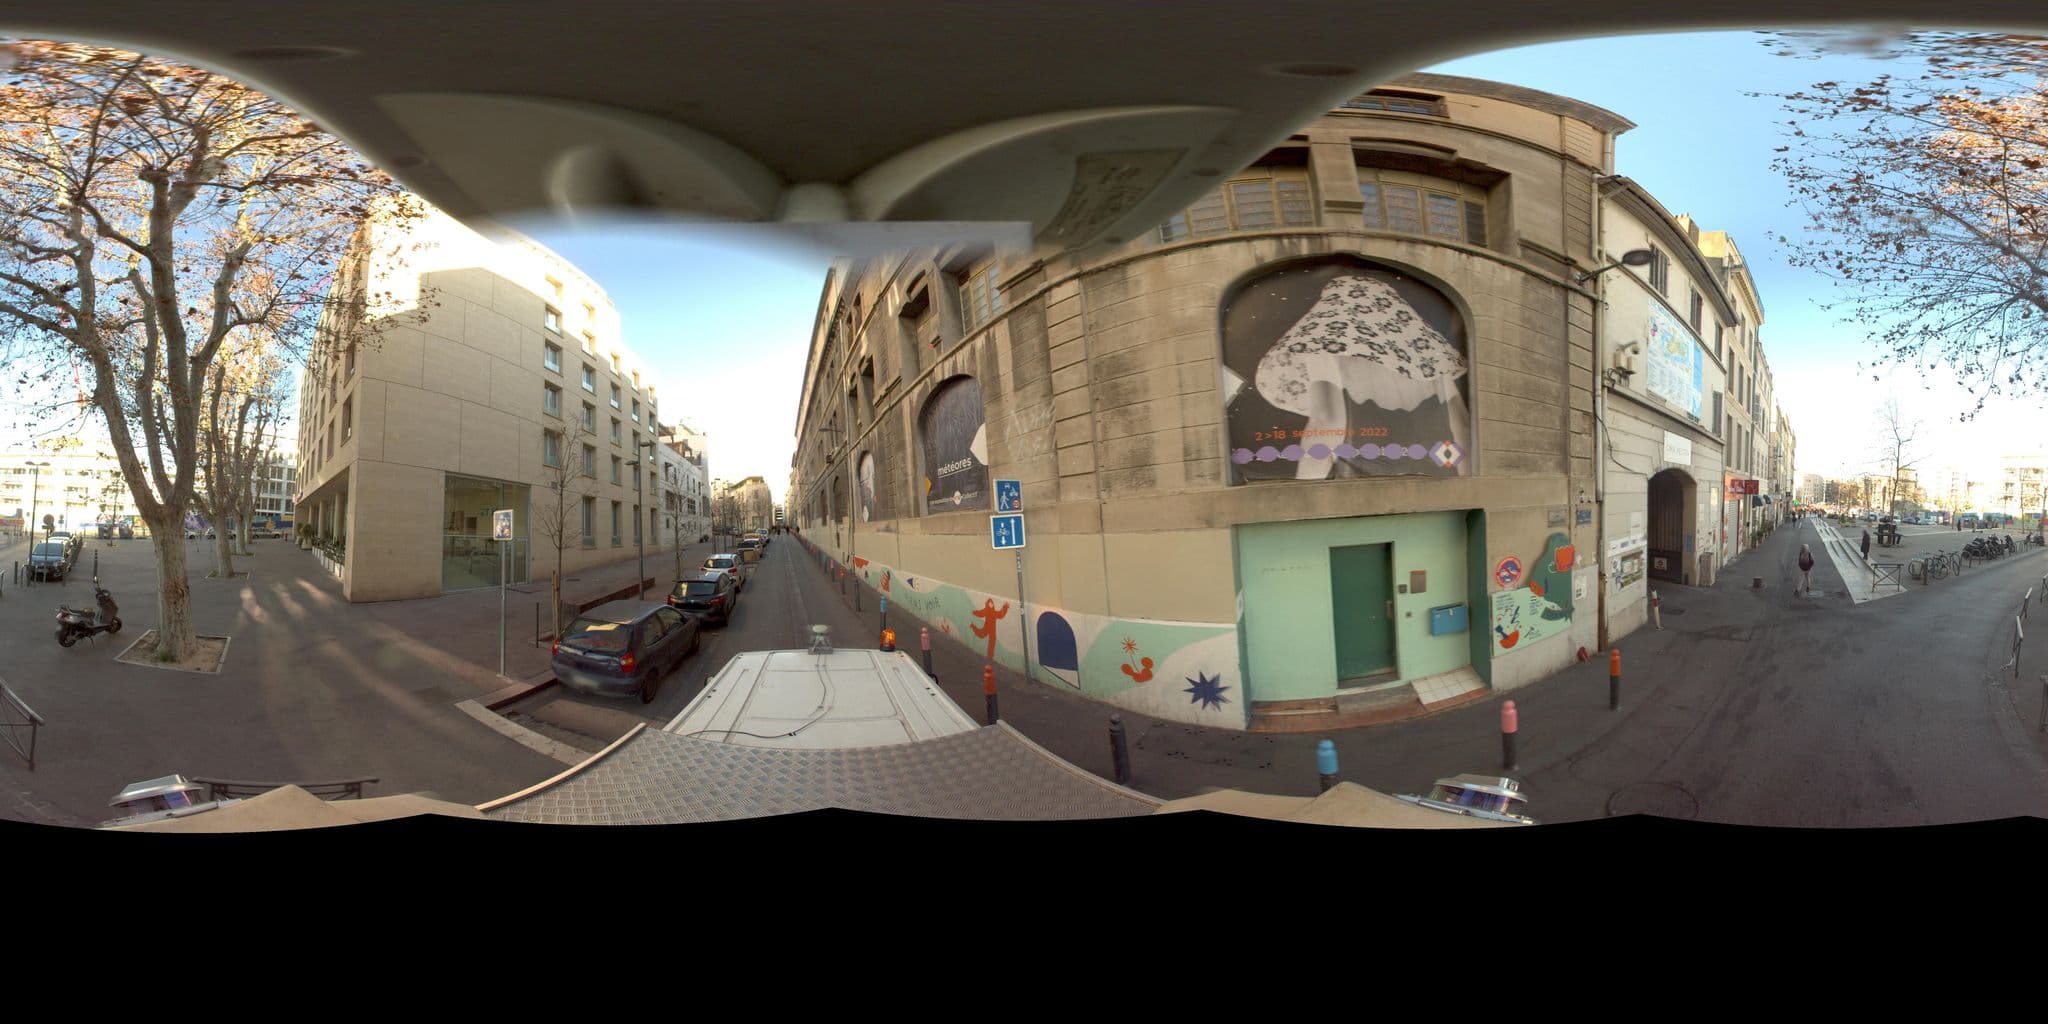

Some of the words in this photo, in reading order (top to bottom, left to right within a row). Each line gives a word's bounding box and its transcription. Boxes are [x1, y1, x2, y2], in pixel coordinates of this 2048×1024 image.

[1292, 428, 1355, 439] septembre
[1360, 425, 1388, 437] 2022
[937, 457, 972, 476] météores
